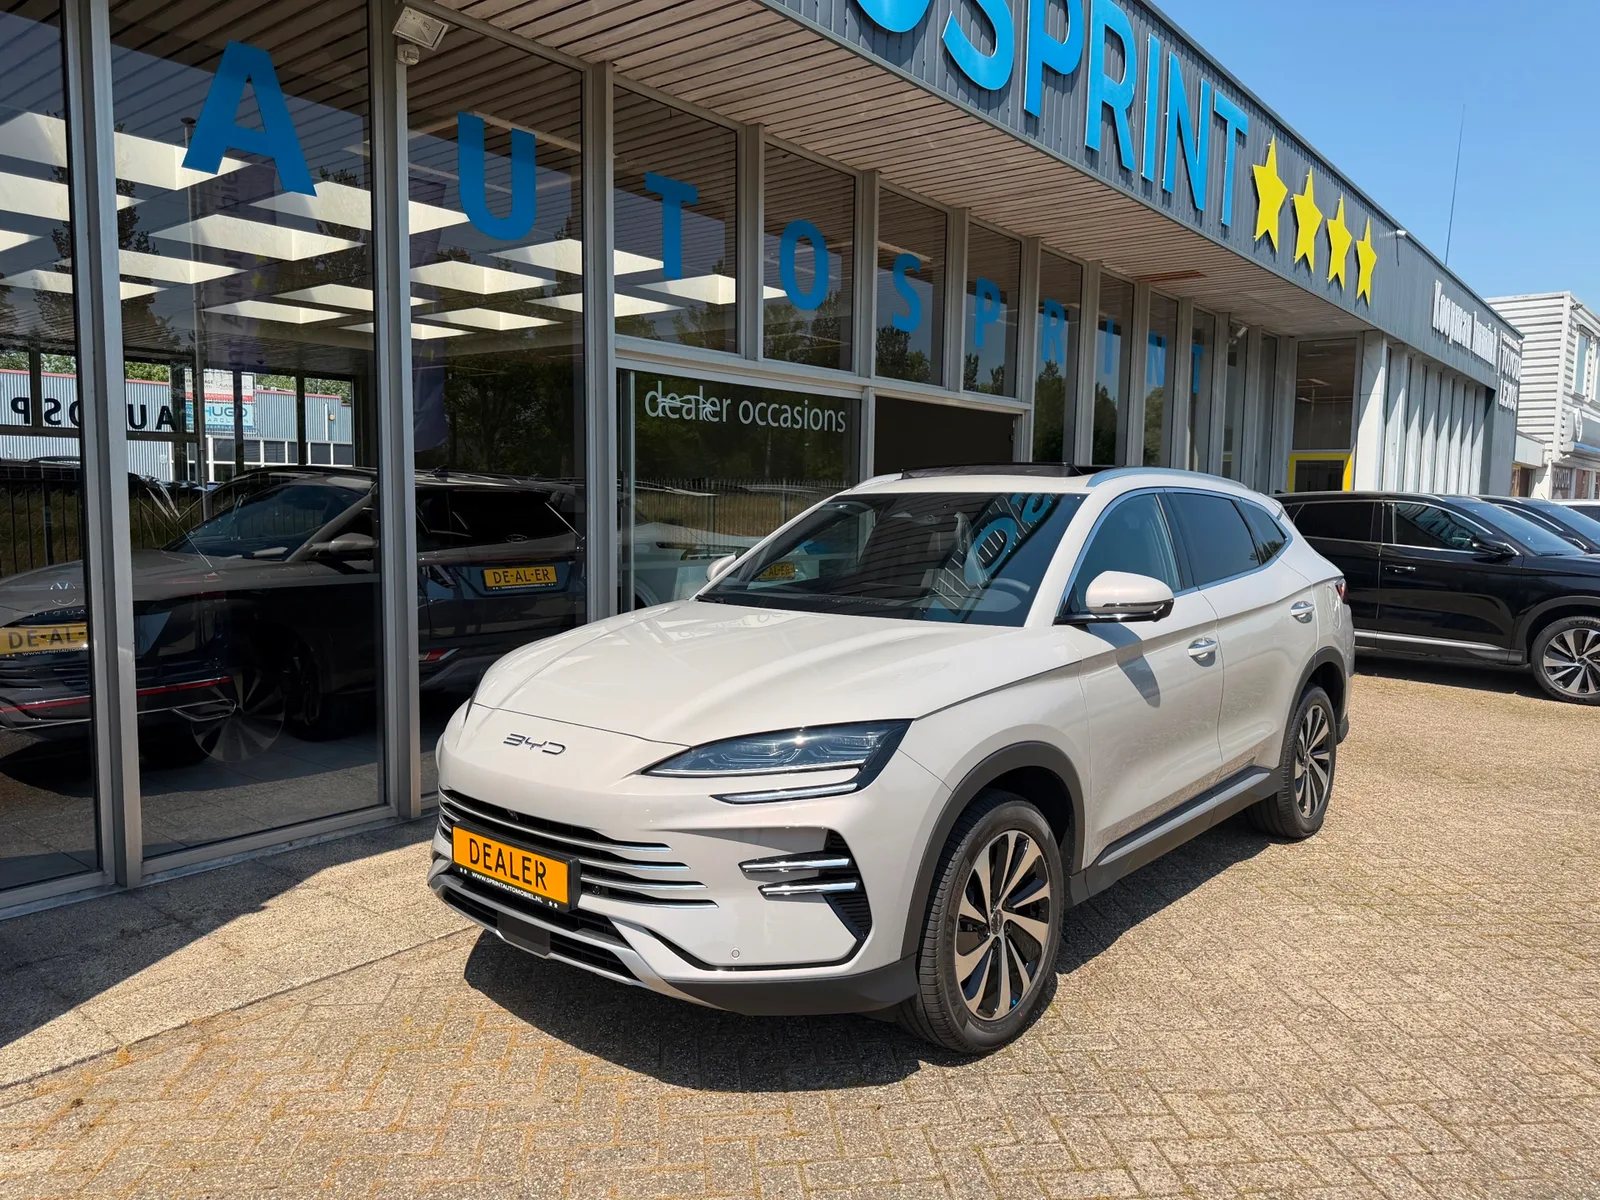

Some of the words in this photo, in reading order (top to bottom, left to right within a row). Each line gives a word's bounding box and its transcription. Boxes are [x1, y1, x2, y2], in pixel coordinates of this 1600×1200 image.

[856, 0, 1248, 227] SPRINT
[1432, 279, 1472, 350] Koopman
[645, 380, 731, 422] dealer
[738, 399, 846, 433] occasions
[493, 567, 550, 584] DE-AL-ER
[8, 627, 86, 650] DE-AL-
[503, 733, 566, 755] BYD
[469, 838, 548, 891] DEALER
[471, 871, 544, 904] WWW.SPRINTAUTOMOBIEL.NL
